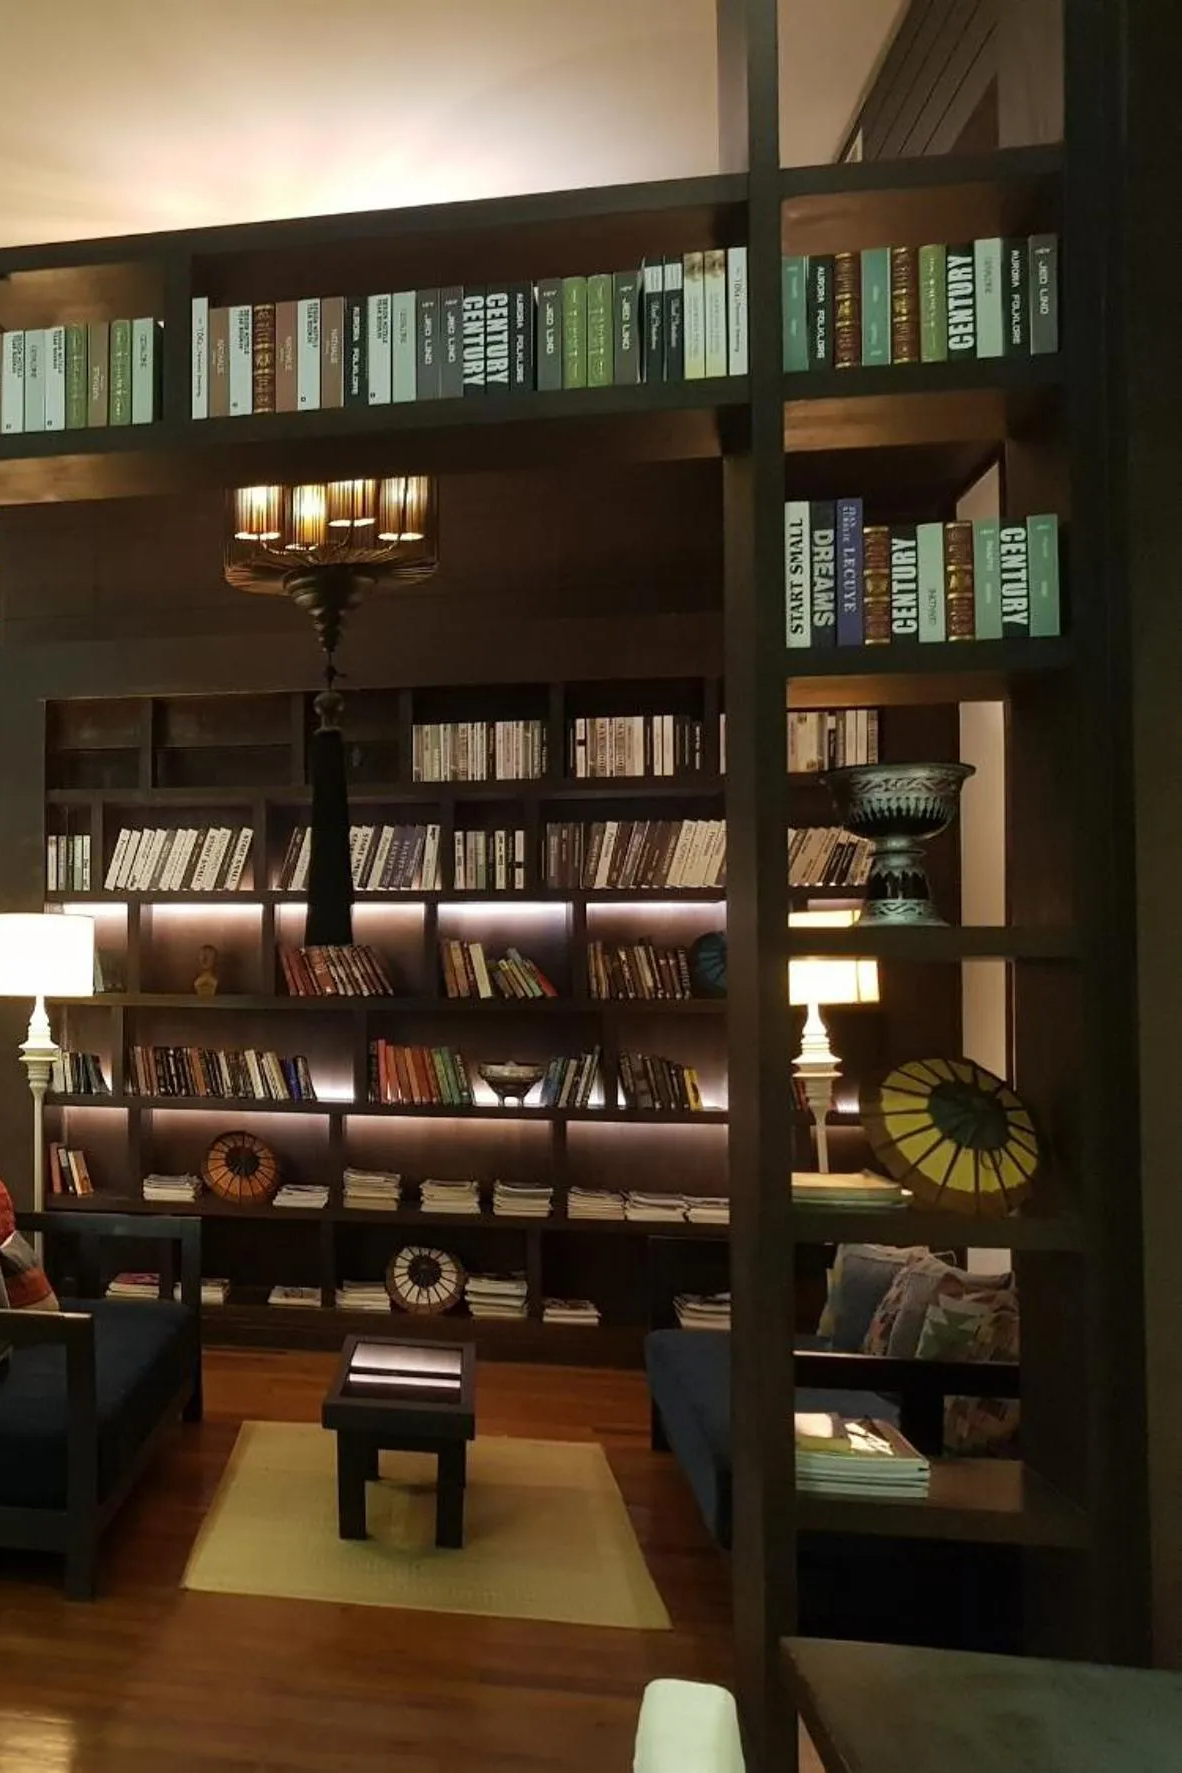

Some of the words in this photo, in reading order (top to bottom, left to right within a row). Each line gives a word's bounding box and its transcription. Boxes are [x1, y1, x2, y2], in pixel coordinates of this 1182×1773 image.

[817, 267, 825, 303] AURORA
[1011, 250, 1020, 288] AURORA
[1039, 261, 1048, 284] JED
[947, 256, 974, 350] CENTURY
[1012, 294, 1020, 344] FOLKLORE
[1040, 288, 1049, 314] LIND
[463, 296, 484, 385] CENTURY
[486, 293, 508, 383] CENTURY
[817, 310, 825, 358] FOLKLORE
[790, 518, 803, 575] SMALL
[813, 529, 835, 626] DREAMS
[843, 548, 856, 613] LECUYE
[892, 538, 917, 634] CENTURY
[1000, 527, 1028, 625] CENTURY
[790, 581, 803, 634] START
